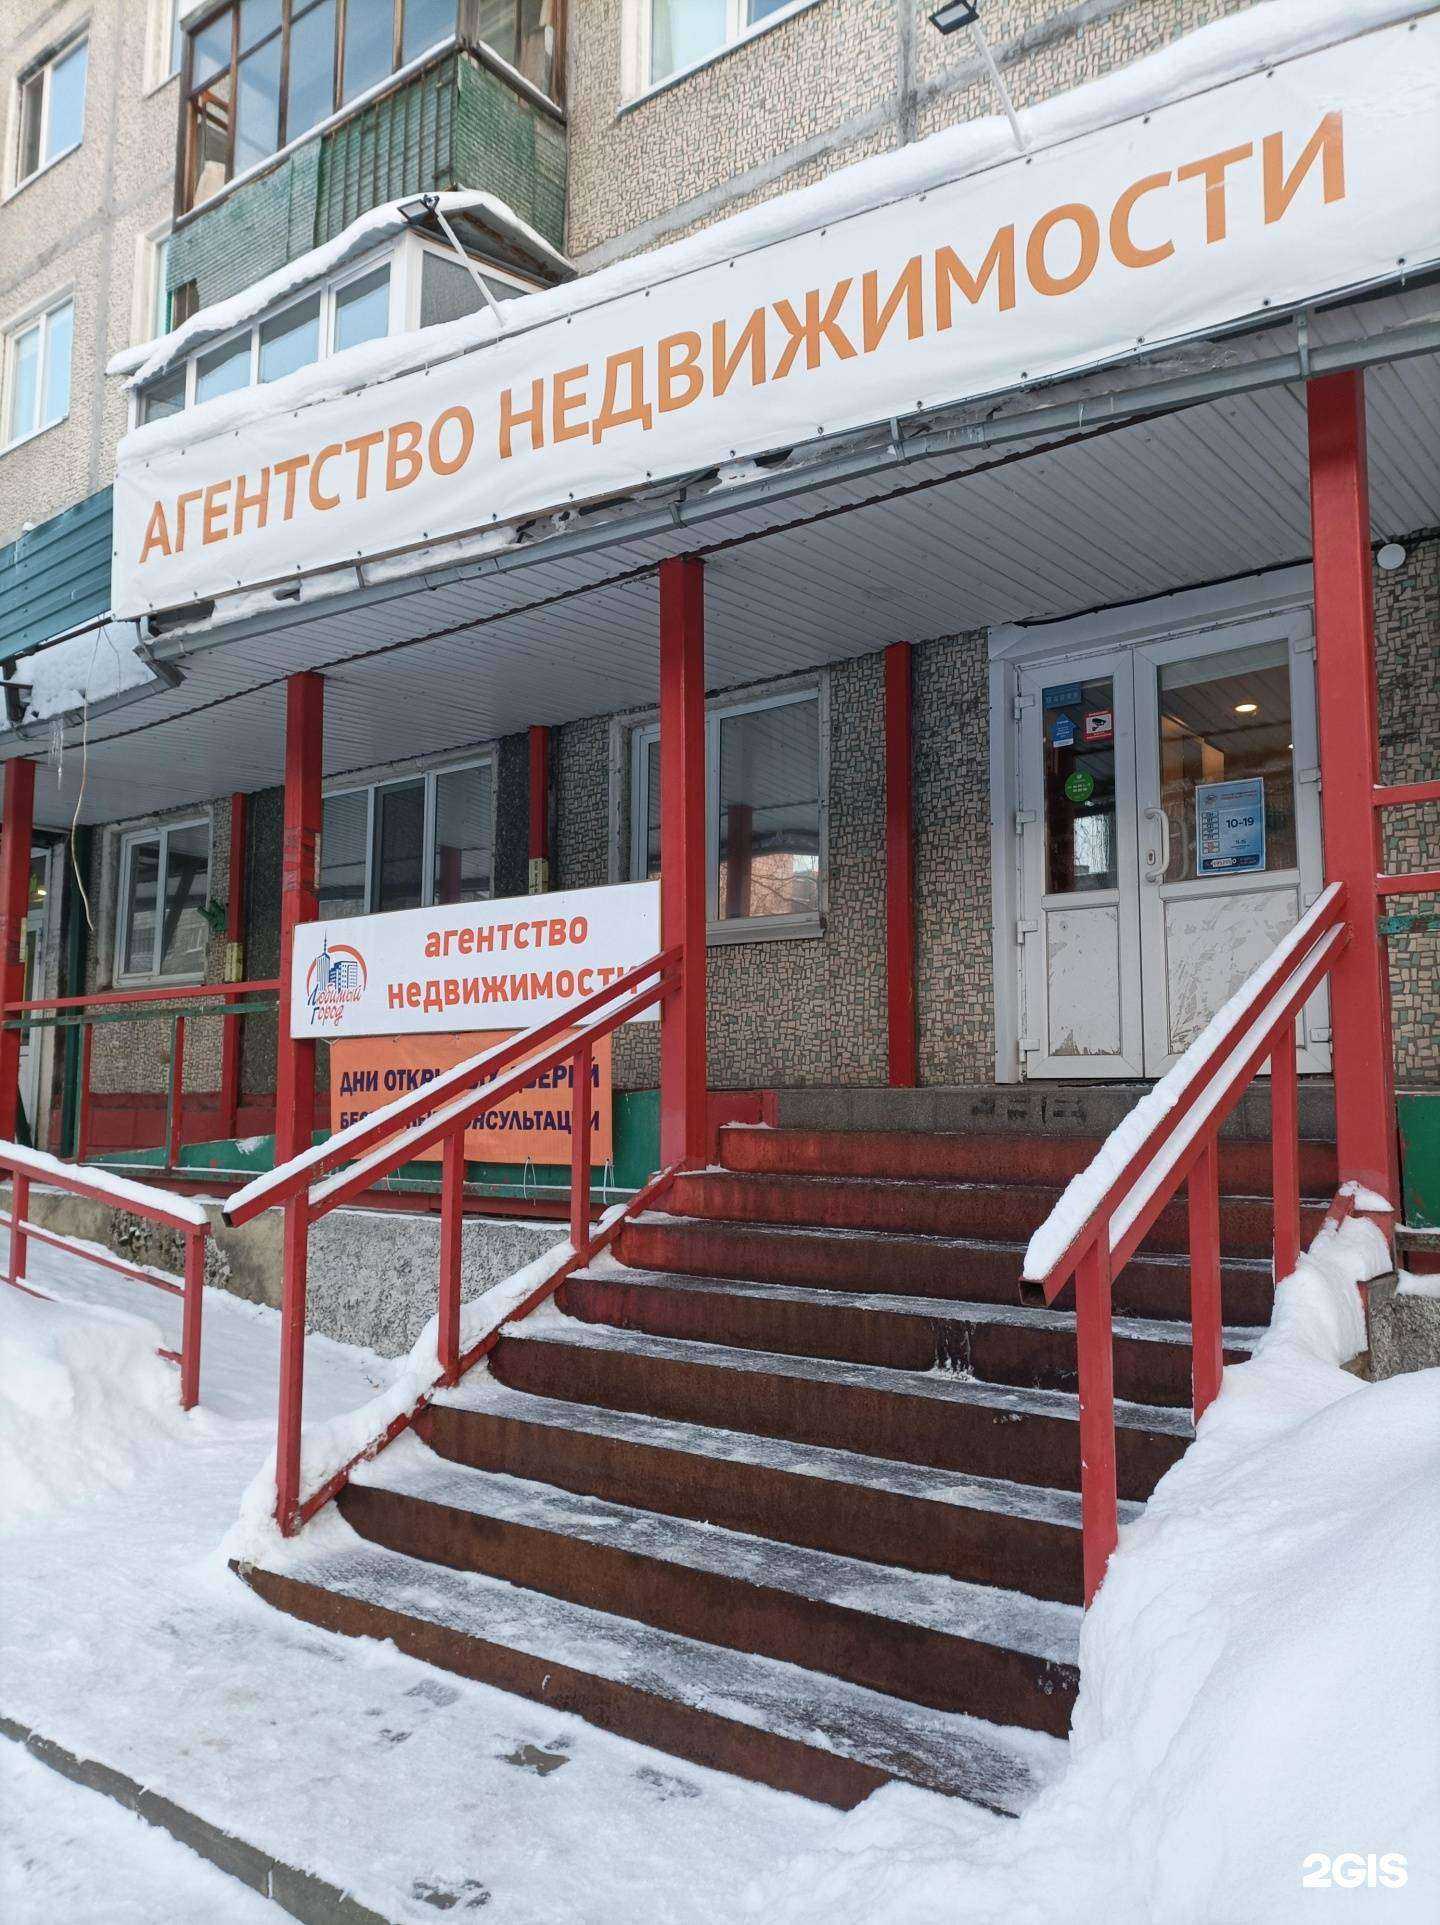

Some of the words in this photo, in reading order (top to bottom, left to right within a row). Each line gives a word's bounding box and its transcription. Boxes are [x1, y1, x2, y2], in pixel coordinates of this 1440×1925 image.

[139, 406, 475, 563] АГЕНТСТВО
[498, 110, 1346, 459] НЕДВИЖИМОСТИ
[1226, 817, 1254, 828] 10-19
[424, 916, 588, 958] агентство
[340, 1068, 378, 1096] ДНИ
